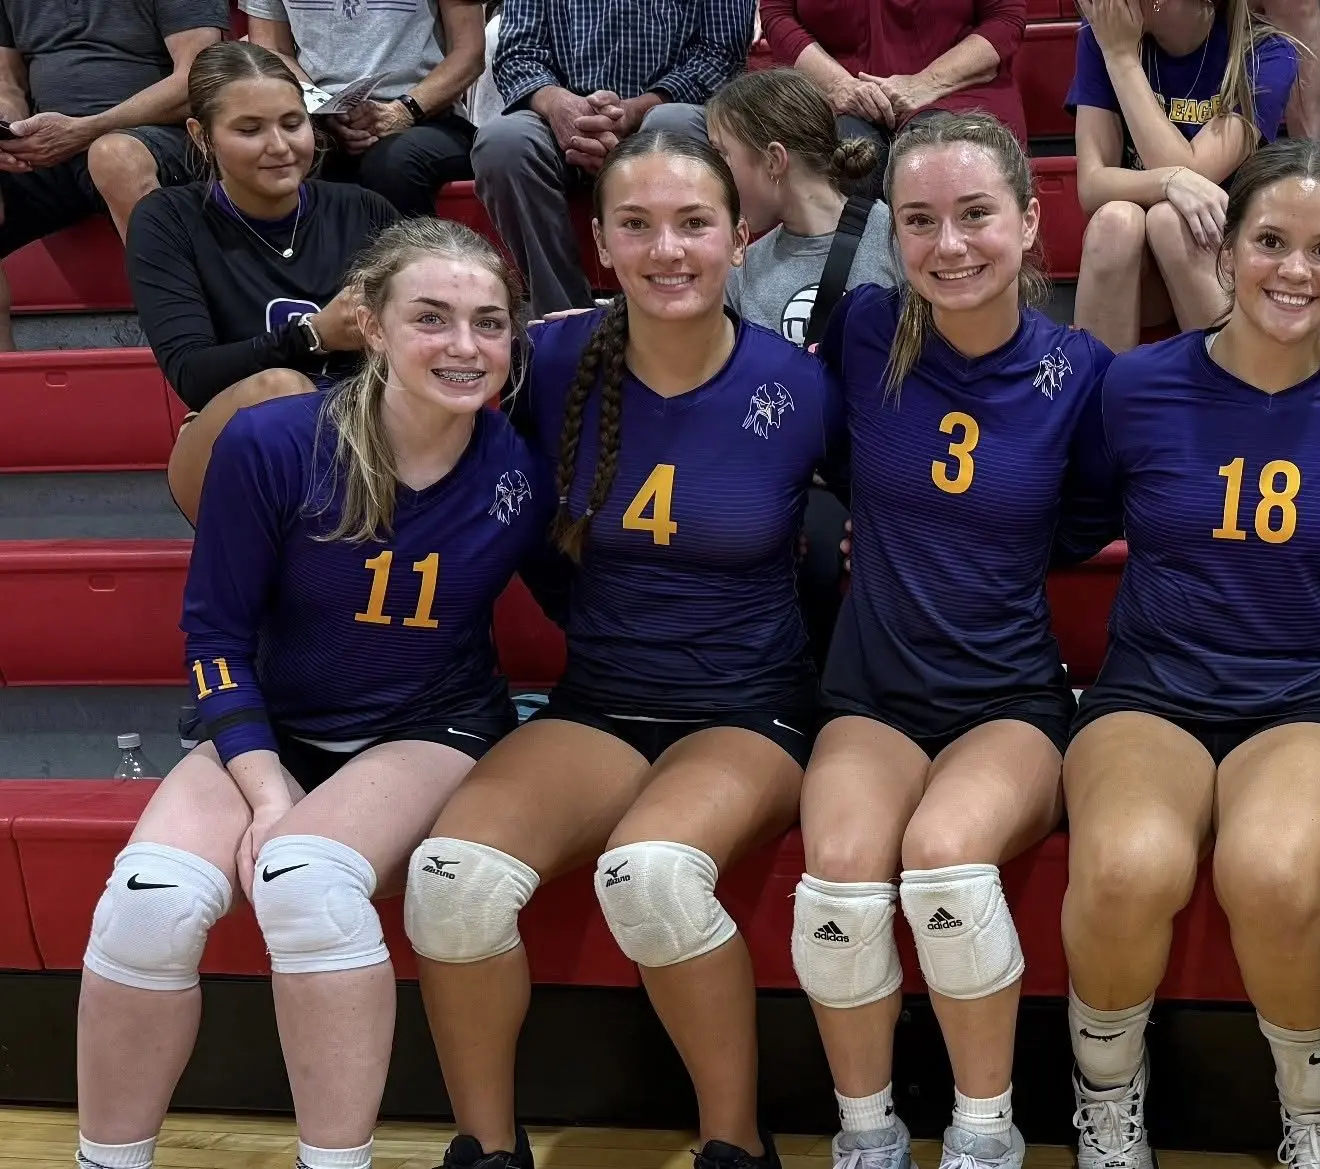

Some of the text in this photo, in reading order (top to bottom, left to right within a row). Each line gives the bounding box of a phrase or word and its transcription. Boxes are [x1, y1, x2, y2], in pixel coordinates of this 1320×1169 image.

[931, 411, 980, 495] 3
[622, 463, 678, 546] 4
[1212, 457, 1302, 544] 18
[354, 550, 440, 629] 11
[192, 657, 239, 700] 11
[421, 864, 456, 880] MIZUNO
[605, 874, 631, 888] MIZUNO
[813, 931, 850, 943] adidas
[926, 918, 963, 931] adidas
